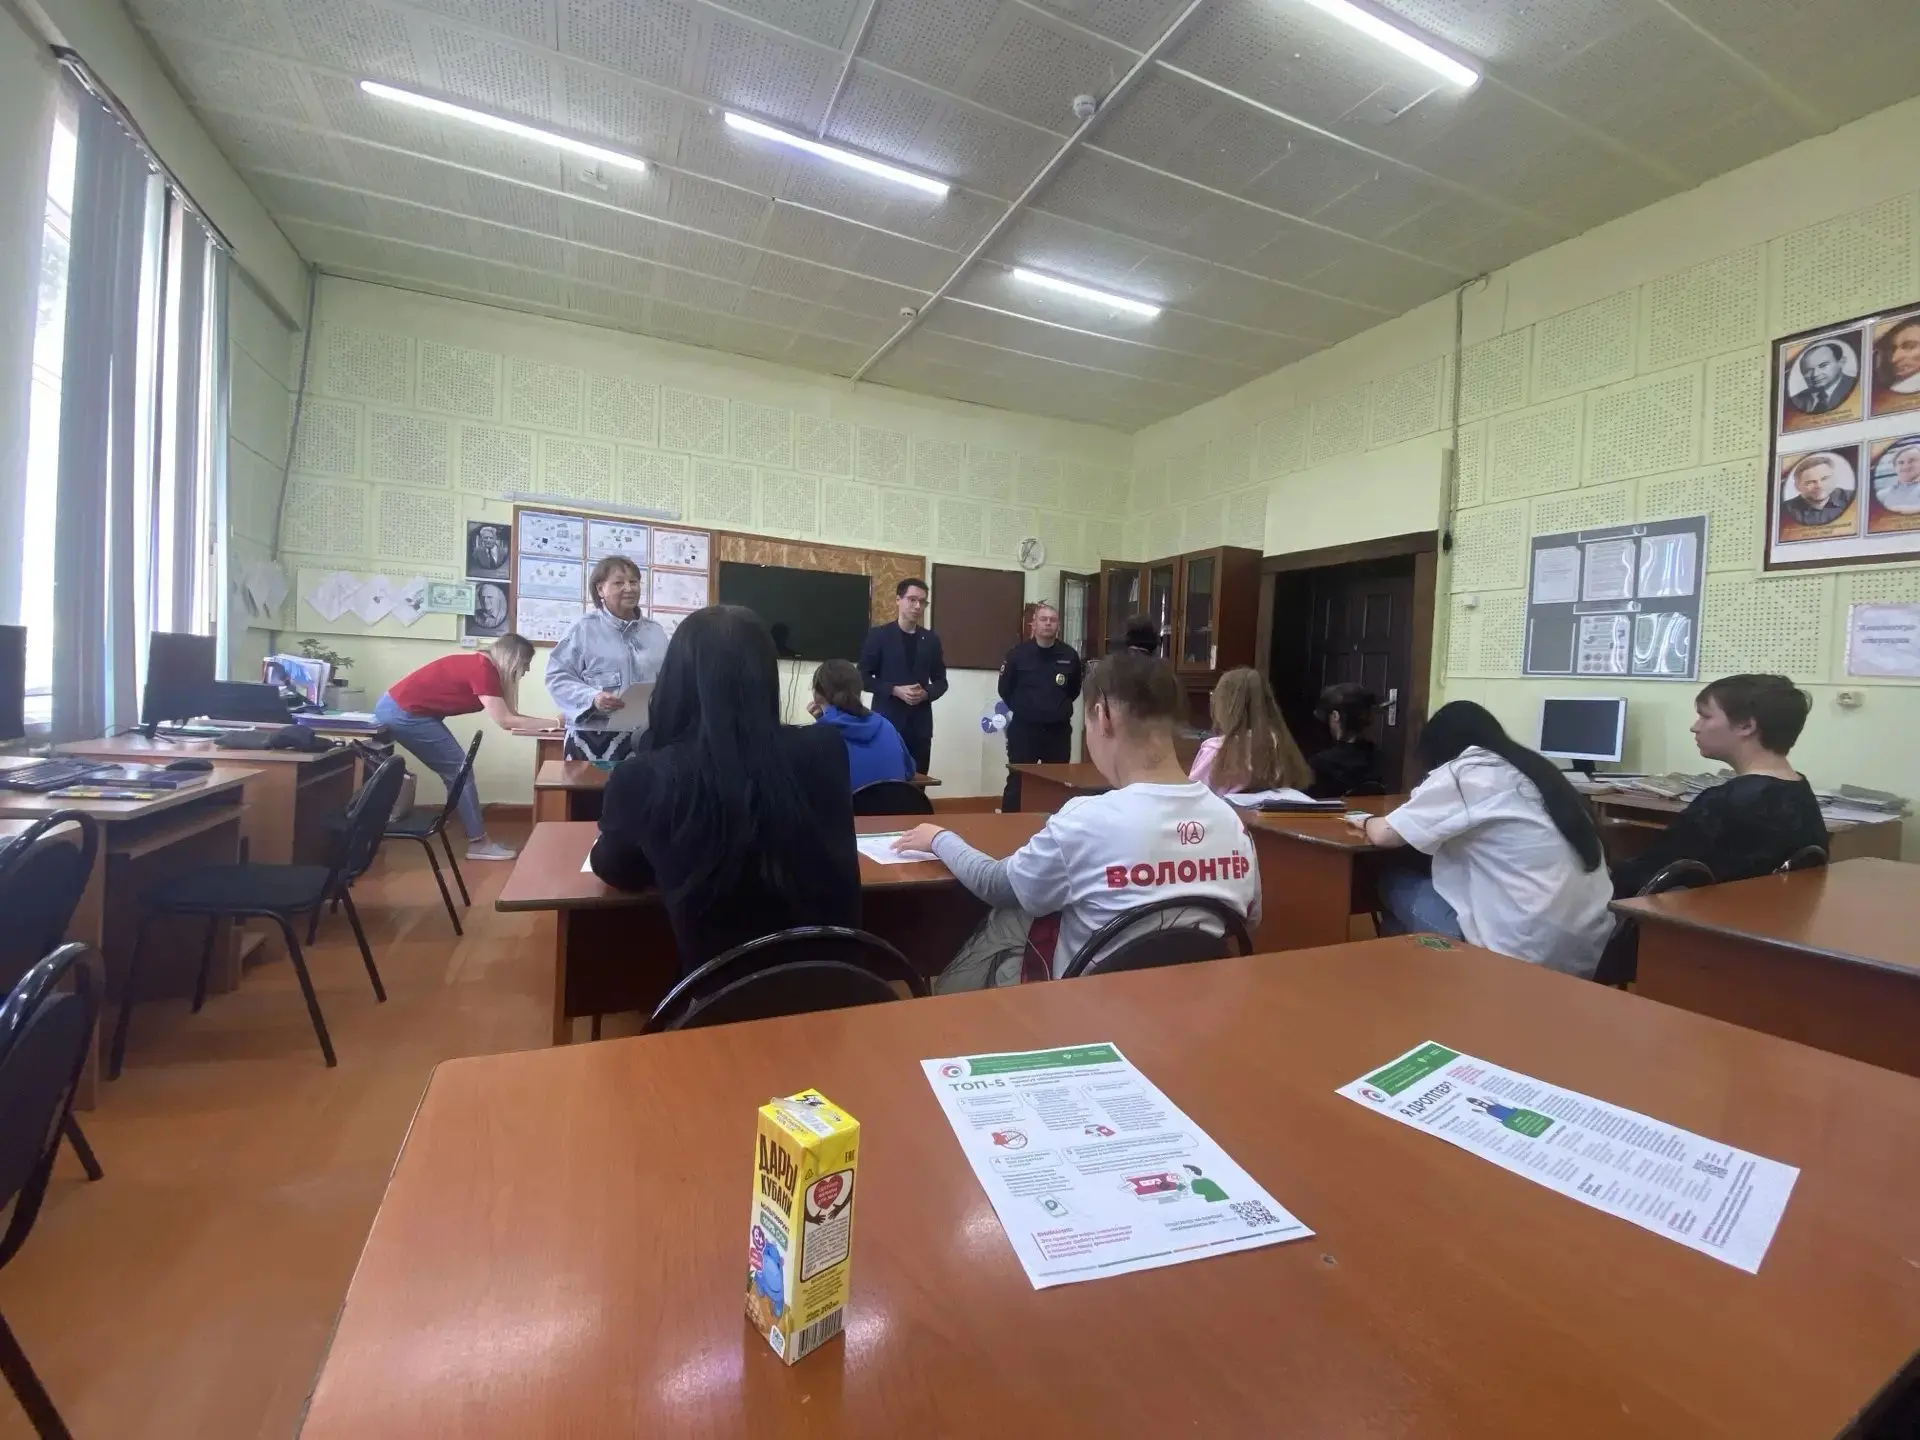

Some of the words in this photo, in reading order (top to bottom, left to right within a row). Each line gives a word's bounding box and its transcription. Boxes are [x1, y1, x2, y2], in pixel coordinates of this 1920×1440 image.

[1106, 850, 1249, 888] ВОЛОНТЁР
[949, 1079, 1005, 1092] ТОП-5
[1407, 1081, 1458, 1114] ДРОППЕР?
[1399, 1108, 1416, 1117] Я
[759, 1133, 798, 1197] ДАРЫ
[761, 1174, 792, 1218] КУБАНИ
